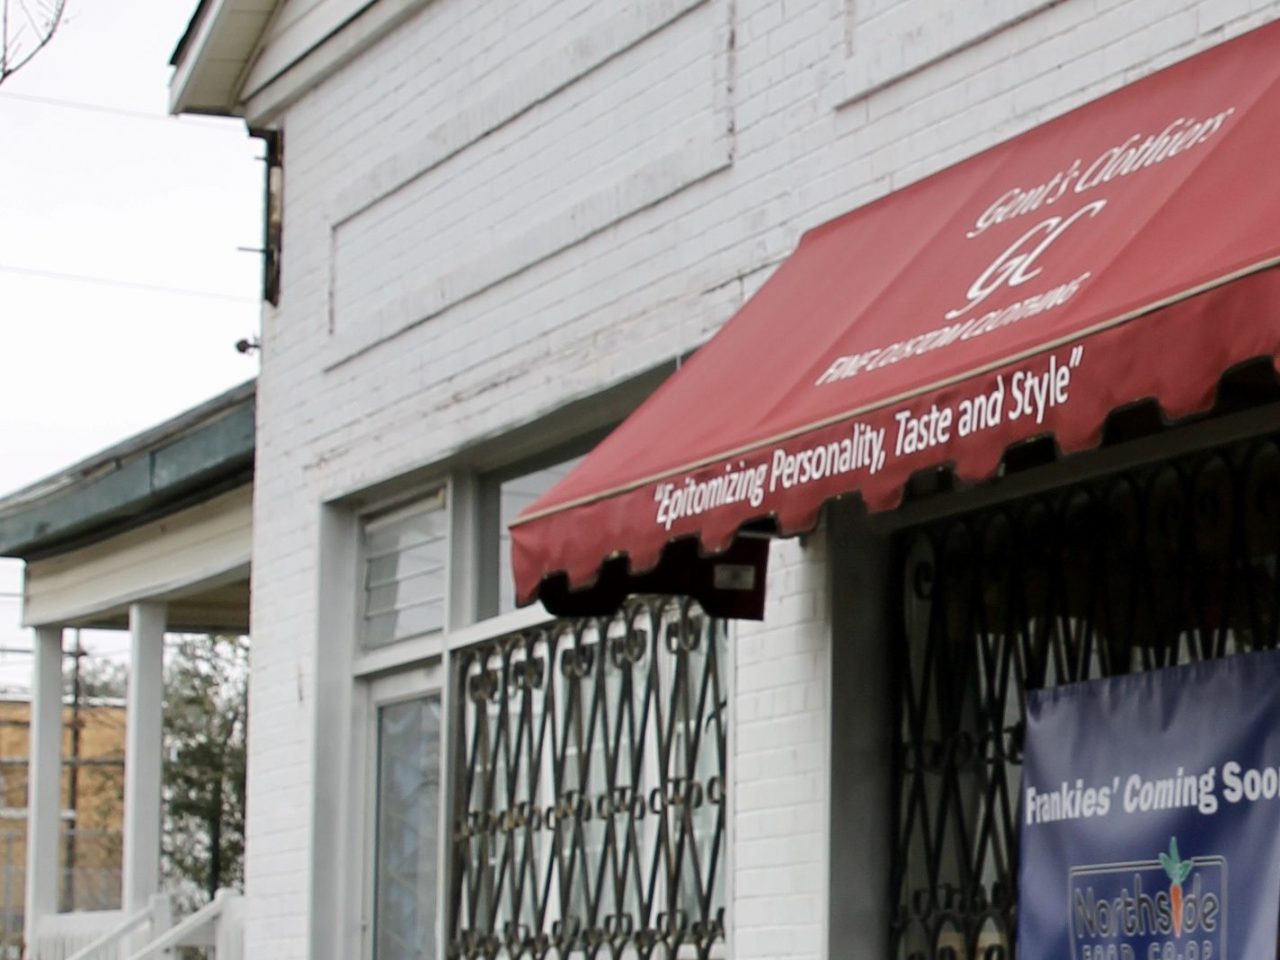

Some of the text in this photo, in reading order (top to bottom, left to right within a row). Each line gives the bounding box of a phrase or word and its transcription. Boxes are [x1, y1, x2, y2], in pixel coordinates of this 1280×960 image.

[1074, 107, 1235, 194] Clothiers
[815, 271, 1091, 386] FINE CUSTOM CLOTHING
[769, 422, 886, 493] Personality,
[894, 403, 952, 457] Taste
[957, 375, 1004, 438] and
[1025, 776, 1120, 825] Frankies'
[1123, 766, 1219, 815] Coming
[1074, 872, 1220, 939] Northside
